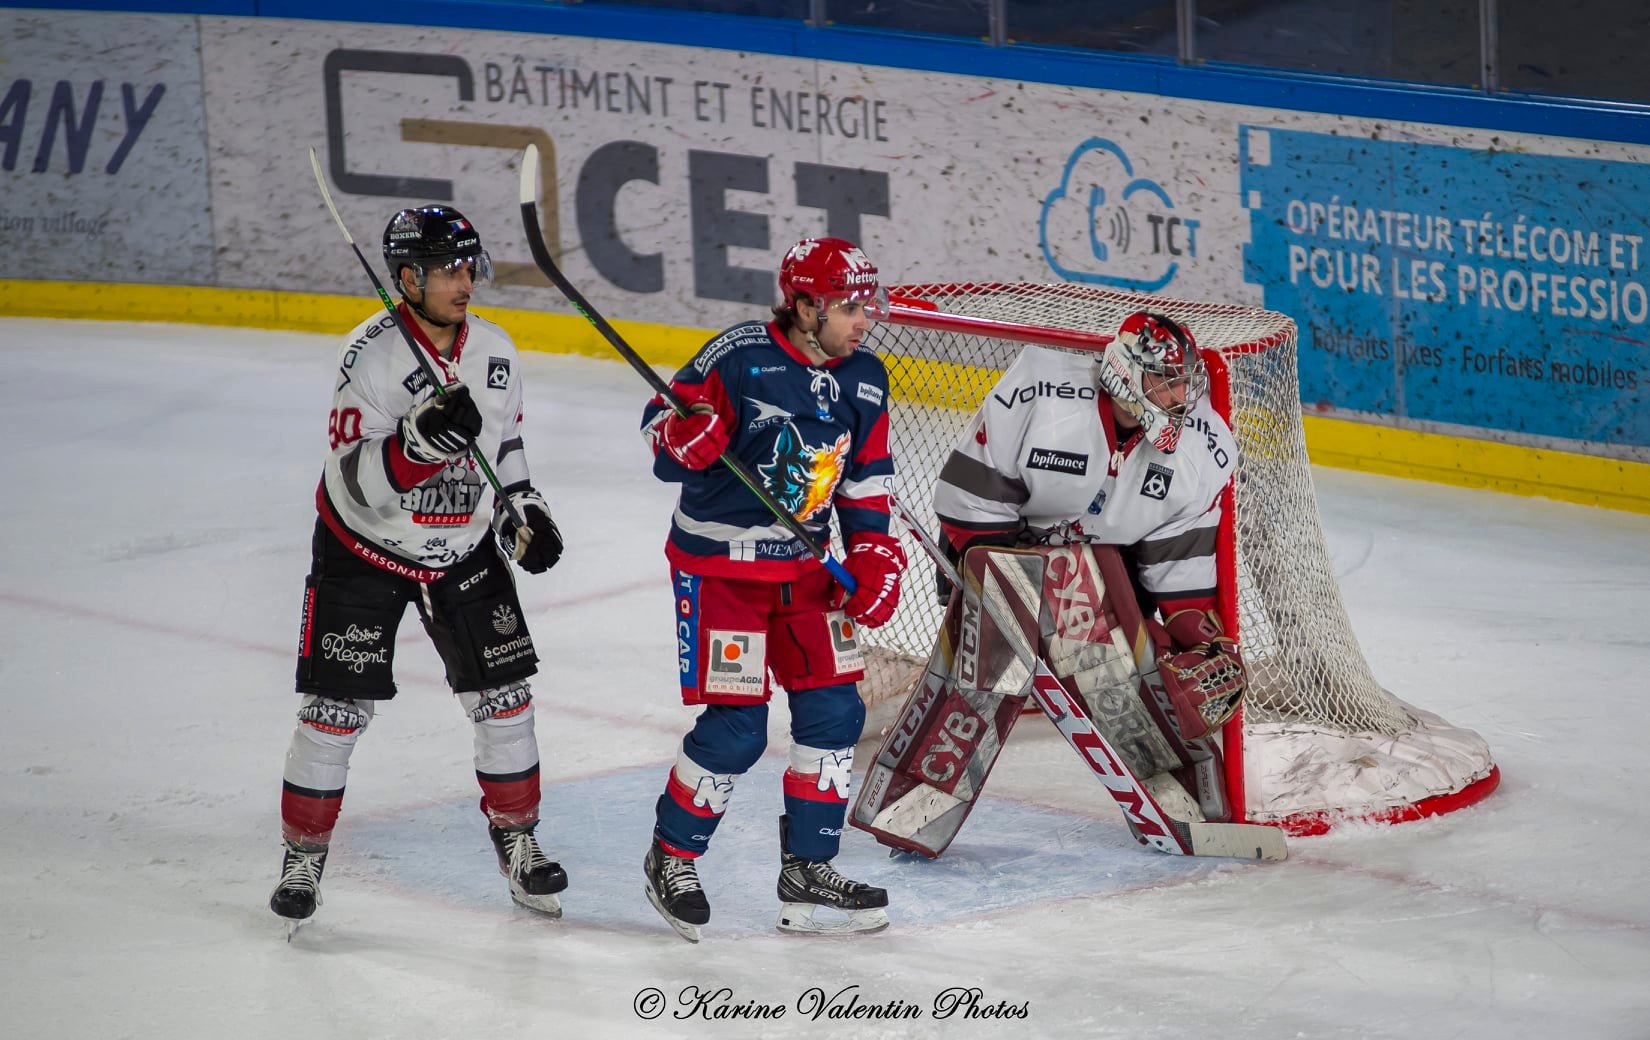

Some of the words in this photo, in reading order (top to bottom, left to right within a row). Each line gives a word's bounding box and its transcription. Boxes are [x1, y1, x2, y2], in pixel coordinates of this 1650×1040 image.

[485, 54, 673, 117] BÂTIMENT
[695, 80, 753, 123] ET
[752, 74, 889, 142] ÉNERGIE
[456, 237, 478, 248] CCM
[574, 139, 891, 307] CET
[1147, 213, 1200, 257] TCT
[1287, 195, 1454, 253] OPÉRATEUR
[1459, 211, 1599, 267] TÉLÉCOM
[1610, 233, 1643, 270] ET
[792, 275, 814, 284] CCM
[1289, 245, 1382, 295] POUR
[1391, 257, 1447, 303] LES
[1457, 264, 1648, 324] PROFESSIO
[337, 315, 397, 393] Voltéo
[1462, 344, 1544, 380] Forfaits
[1550, 358, 1637, 390] mobiles
[993, 380, 1096, 410] Voltéo
[748, 416, 779, 430] ACTE
[1032, 451, 1086, 470] bpifrance
[354, 541, 425, 580] PERSONAL
[851, 542, 905, 571] CCM
[458, 568, 488, 591] CCM
[1045, 547, 1096, 637] CYB
[322, 633, 388, 673] Régent
[346, 623, 382, 642] bistro
[888, 684, 936, 759] CCM
[921, 710, 981, 783] CYB
[1031, 673, 1171, 846] CCM
